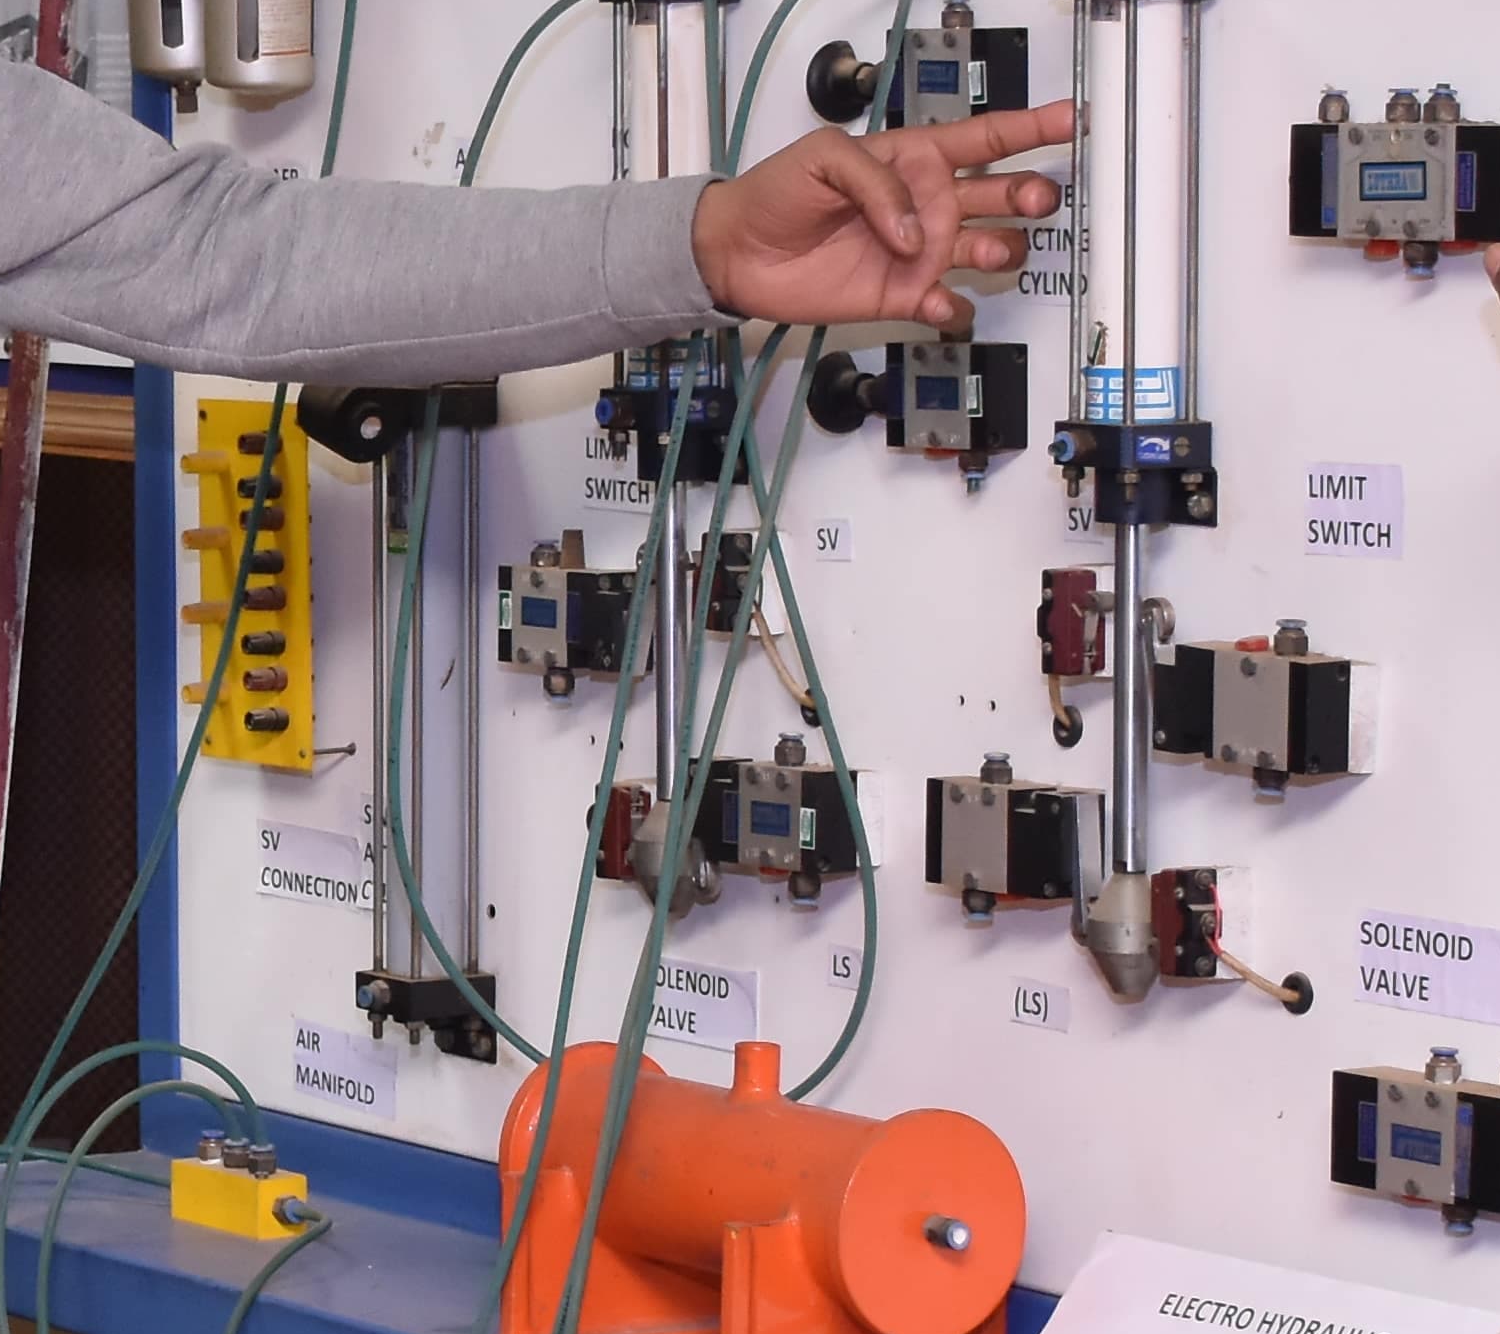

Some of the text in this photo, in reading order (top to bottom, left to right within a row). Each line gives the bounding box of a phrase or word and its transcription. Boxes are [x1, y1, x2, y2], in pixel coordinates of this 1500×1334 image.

[455, 148, 467, 170] A
[1018, 270, 1089, 296] CYLIND
[584, 477, 650, 504] SWITCH
[1308, 473, 1368, 501] LIMIT
[1068, 506, 1093, 532] SV
[816, 527, 839, 551] SV
[1308, 519, 1391, 548] SWITCH
[261, 829, 281, 852] SV
[261, 866, 358, 904] CONNECTION
[1360, 920, 1474, 960] SOLENOID
[833, 954, 851, 979] LS
[656, 965, 729, 999] OLENOID
[1360, 965, 1430, 1002] VALVE
[1014, 986, 1049, 1023] (LS)
[295, 1028, 321, 1054] AIR
[296, 1063, 375, 1105] MANIFOLD
[1159, 1293, 1255, 1330] ELECTRO
